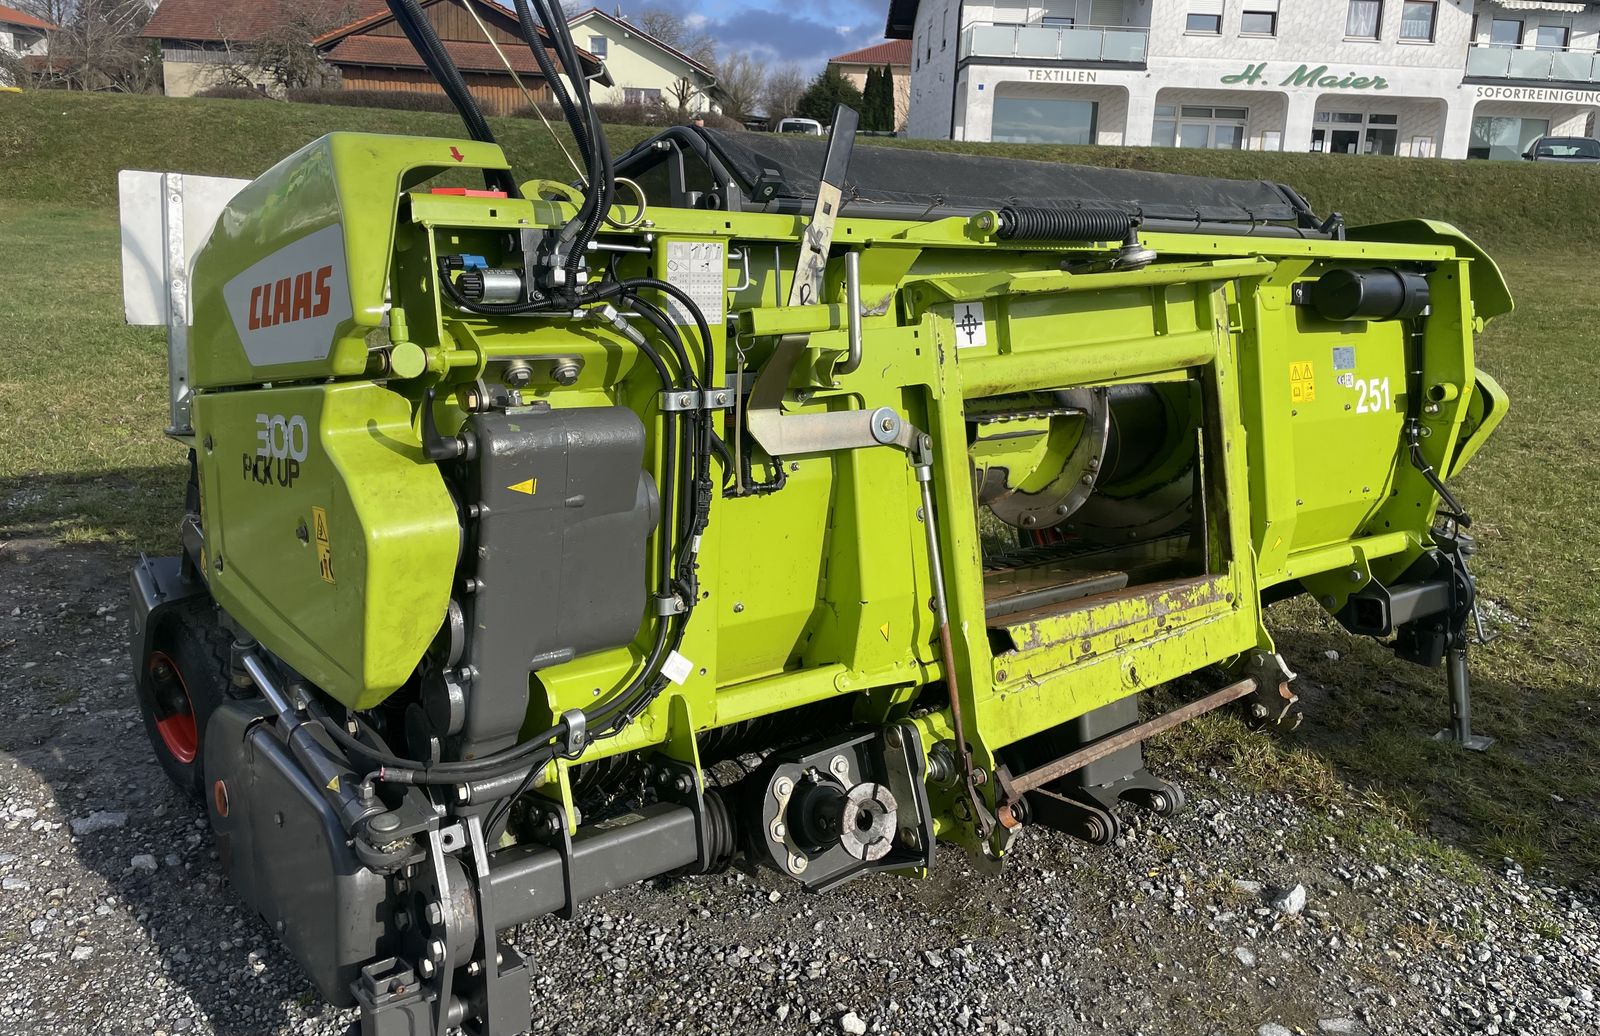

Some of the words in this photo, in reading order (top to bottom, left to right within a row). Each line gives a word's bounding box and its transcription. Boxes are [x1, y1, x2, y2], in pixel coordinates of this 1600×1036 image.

[1028, 69, 1096, 82] TEXTILIEN
[1220, 62, 1267, 85] H.
[1279, 64, 1388, 90] Maier
[249, 265, 332, 331] CLAAS
[1355, 377, 1390, 414] 251
[256, 413, 308, 462] 300
[243, 453, 273, 486] PICK
[277, 457, 300, 488] UP
